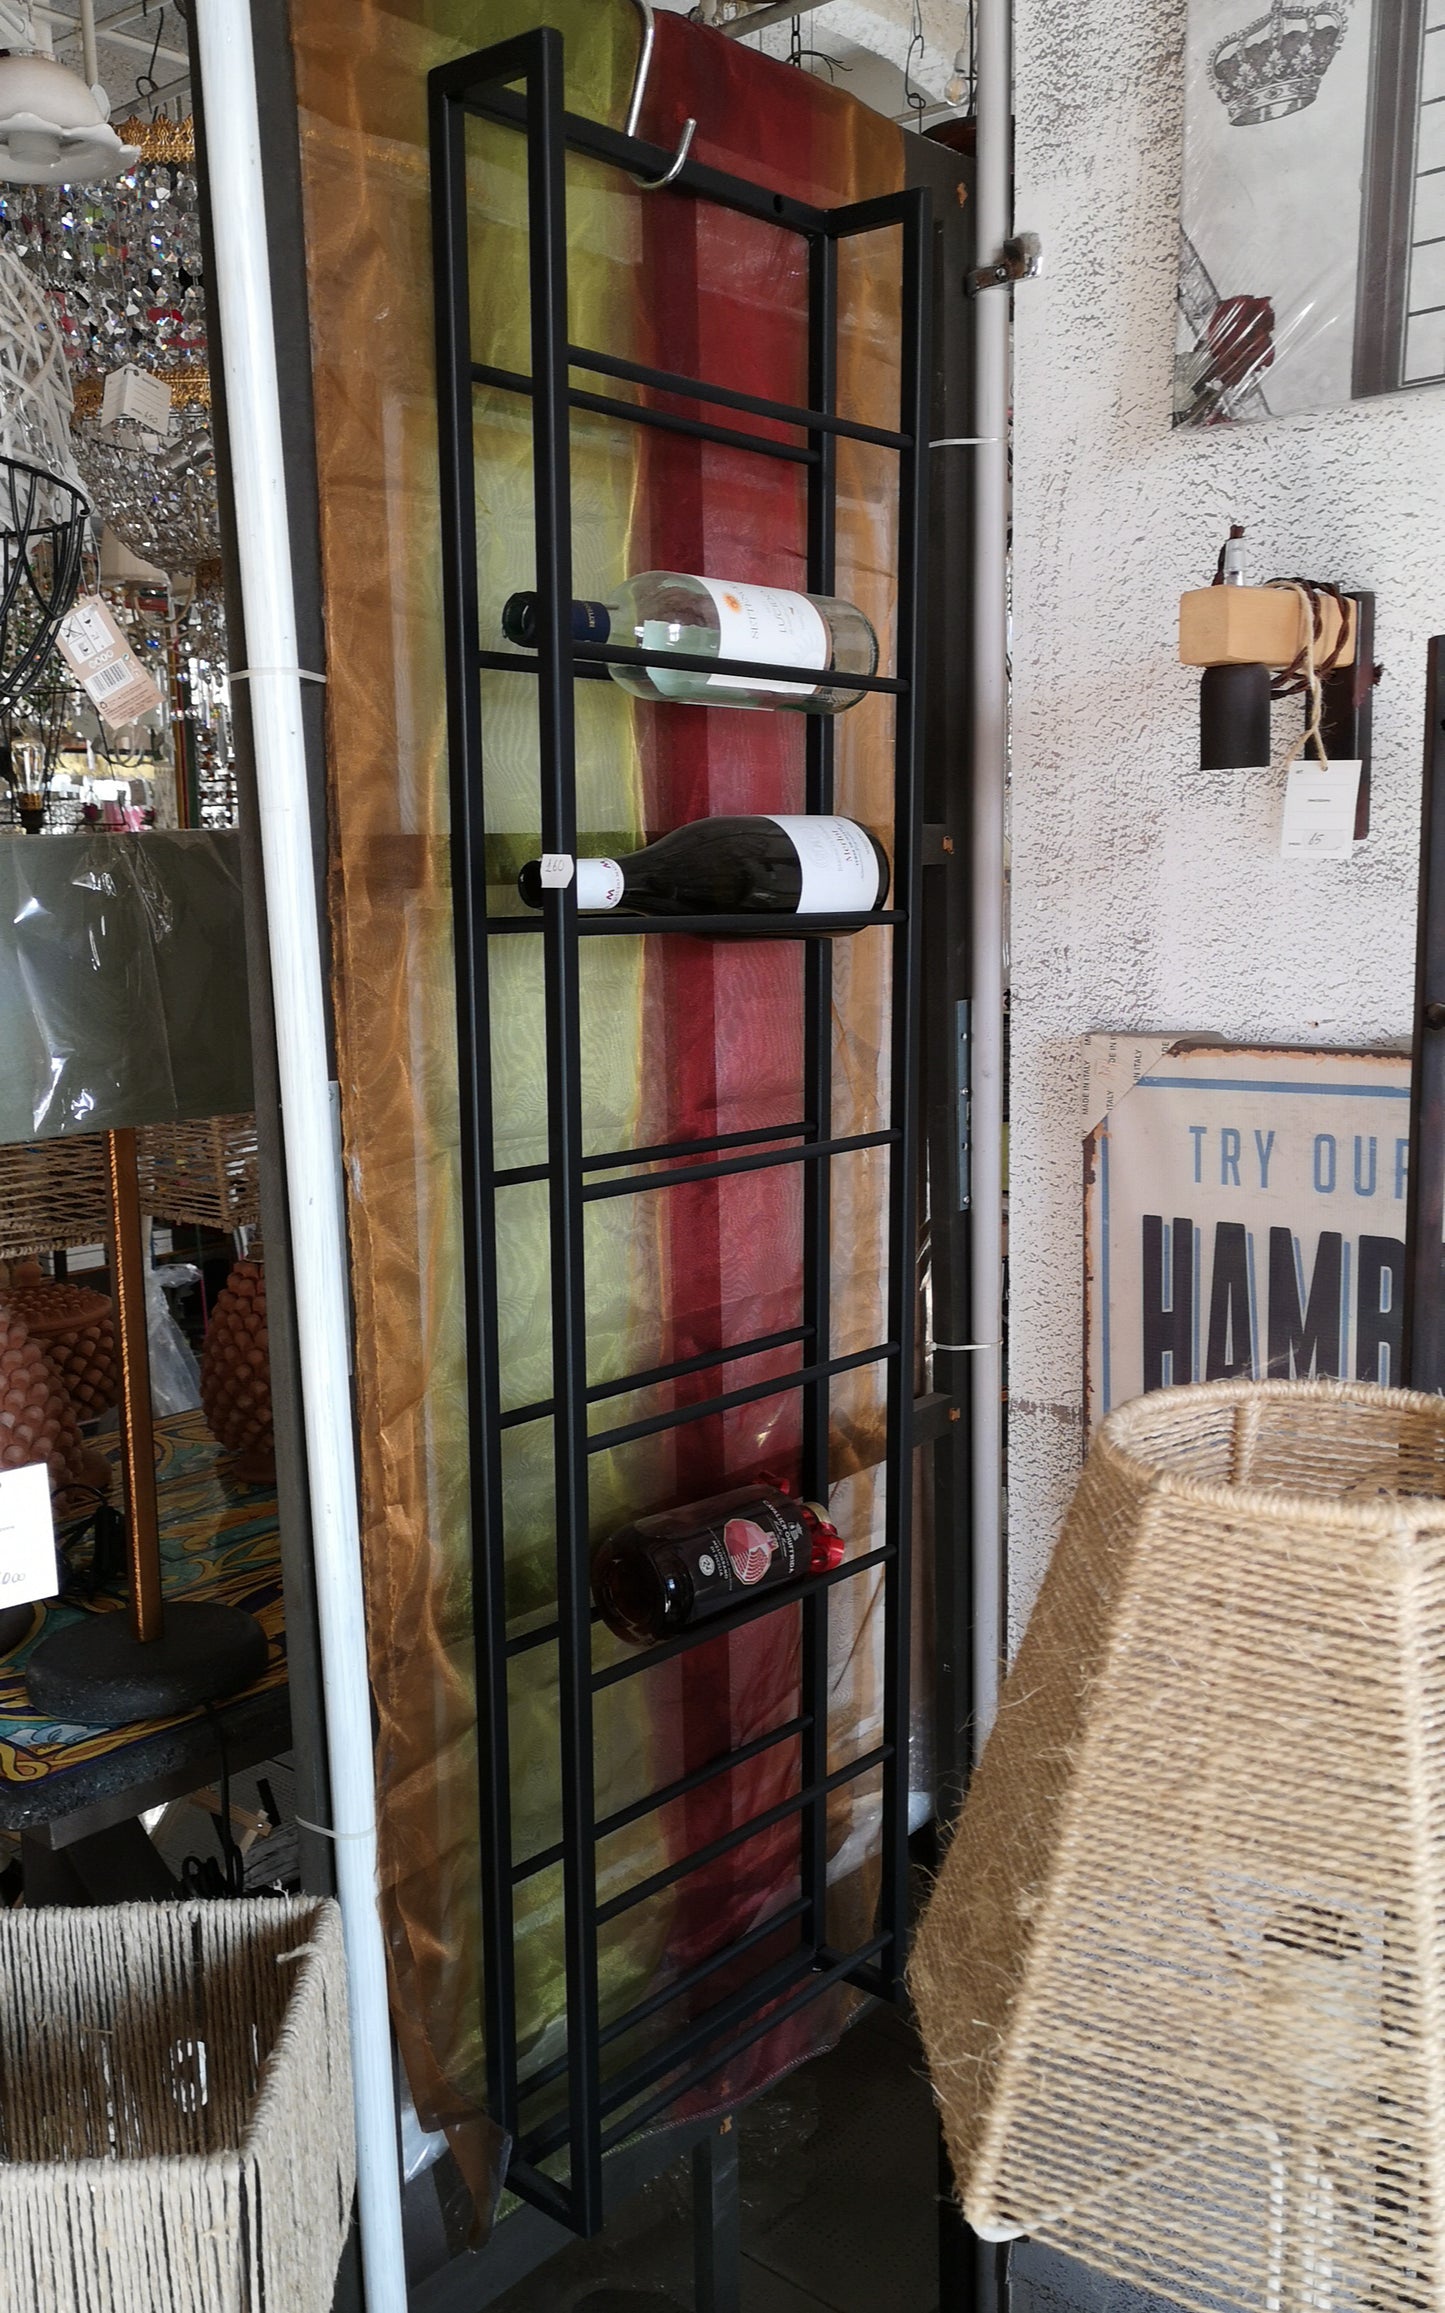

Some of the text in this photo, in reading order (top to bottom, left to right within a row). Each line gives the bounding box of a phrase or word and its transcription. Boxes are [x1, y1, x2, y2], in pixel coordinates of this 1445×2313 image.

[1109, 1041, 1118, 1051] IN
[1083, 1059, 1092, 1080] ITALY
[1133, 1048, 1143, 1070] ITALY
[1082, 1081, 1090, 1092] IN
[1081, 1093, 1090, 1115] MADE
[1106, 1089, 1115, 1111] ITALY
[1189, 1126, 1275, 1188] TRY
